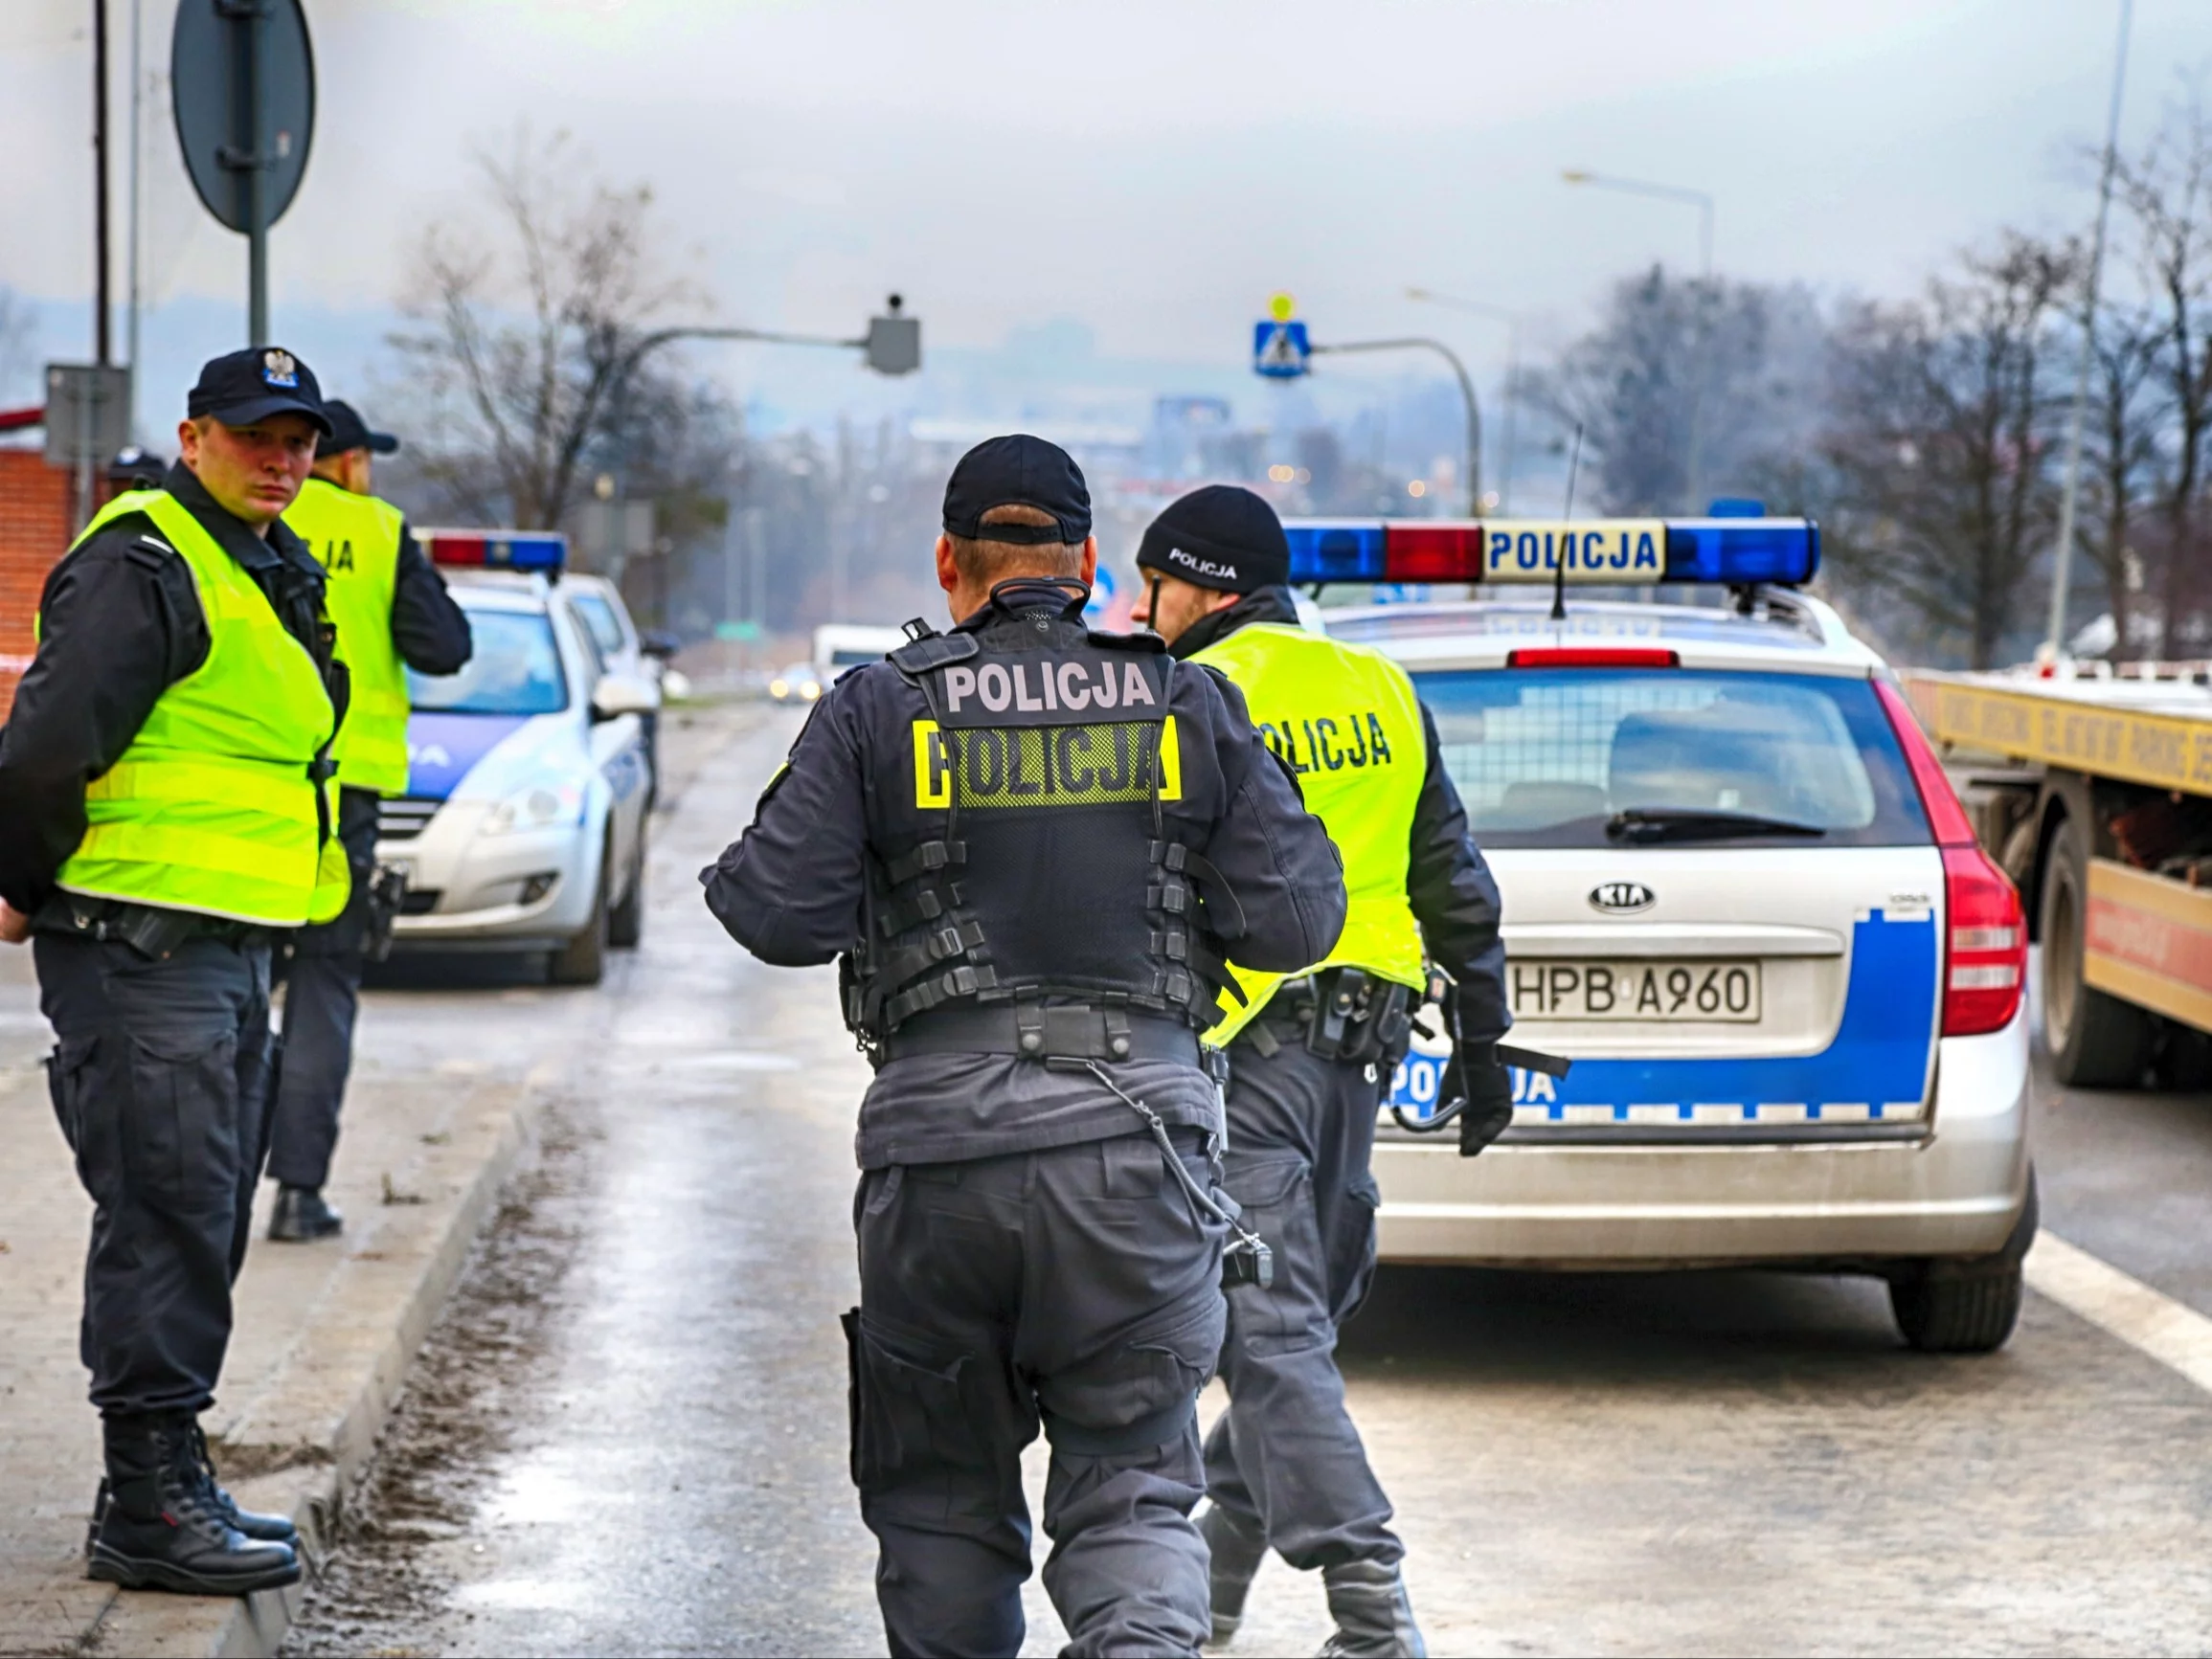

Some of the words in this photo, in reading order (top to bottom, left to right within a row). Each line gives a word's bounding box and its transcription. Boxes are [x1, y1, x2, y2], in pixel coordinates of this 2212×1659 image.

[1168, 548, 1237, 580] POLICJA
[1490, 532, 1658, 570] POLICJA
[944, 661, 1156, 712] POLICJA
[1258, 712, 1391, 773] OLICJA
[1597, 885, 1647, 906] KIA
[1514, 966, 1616, 1013] HPB
[1636, 966, 1751, 1013] A960
